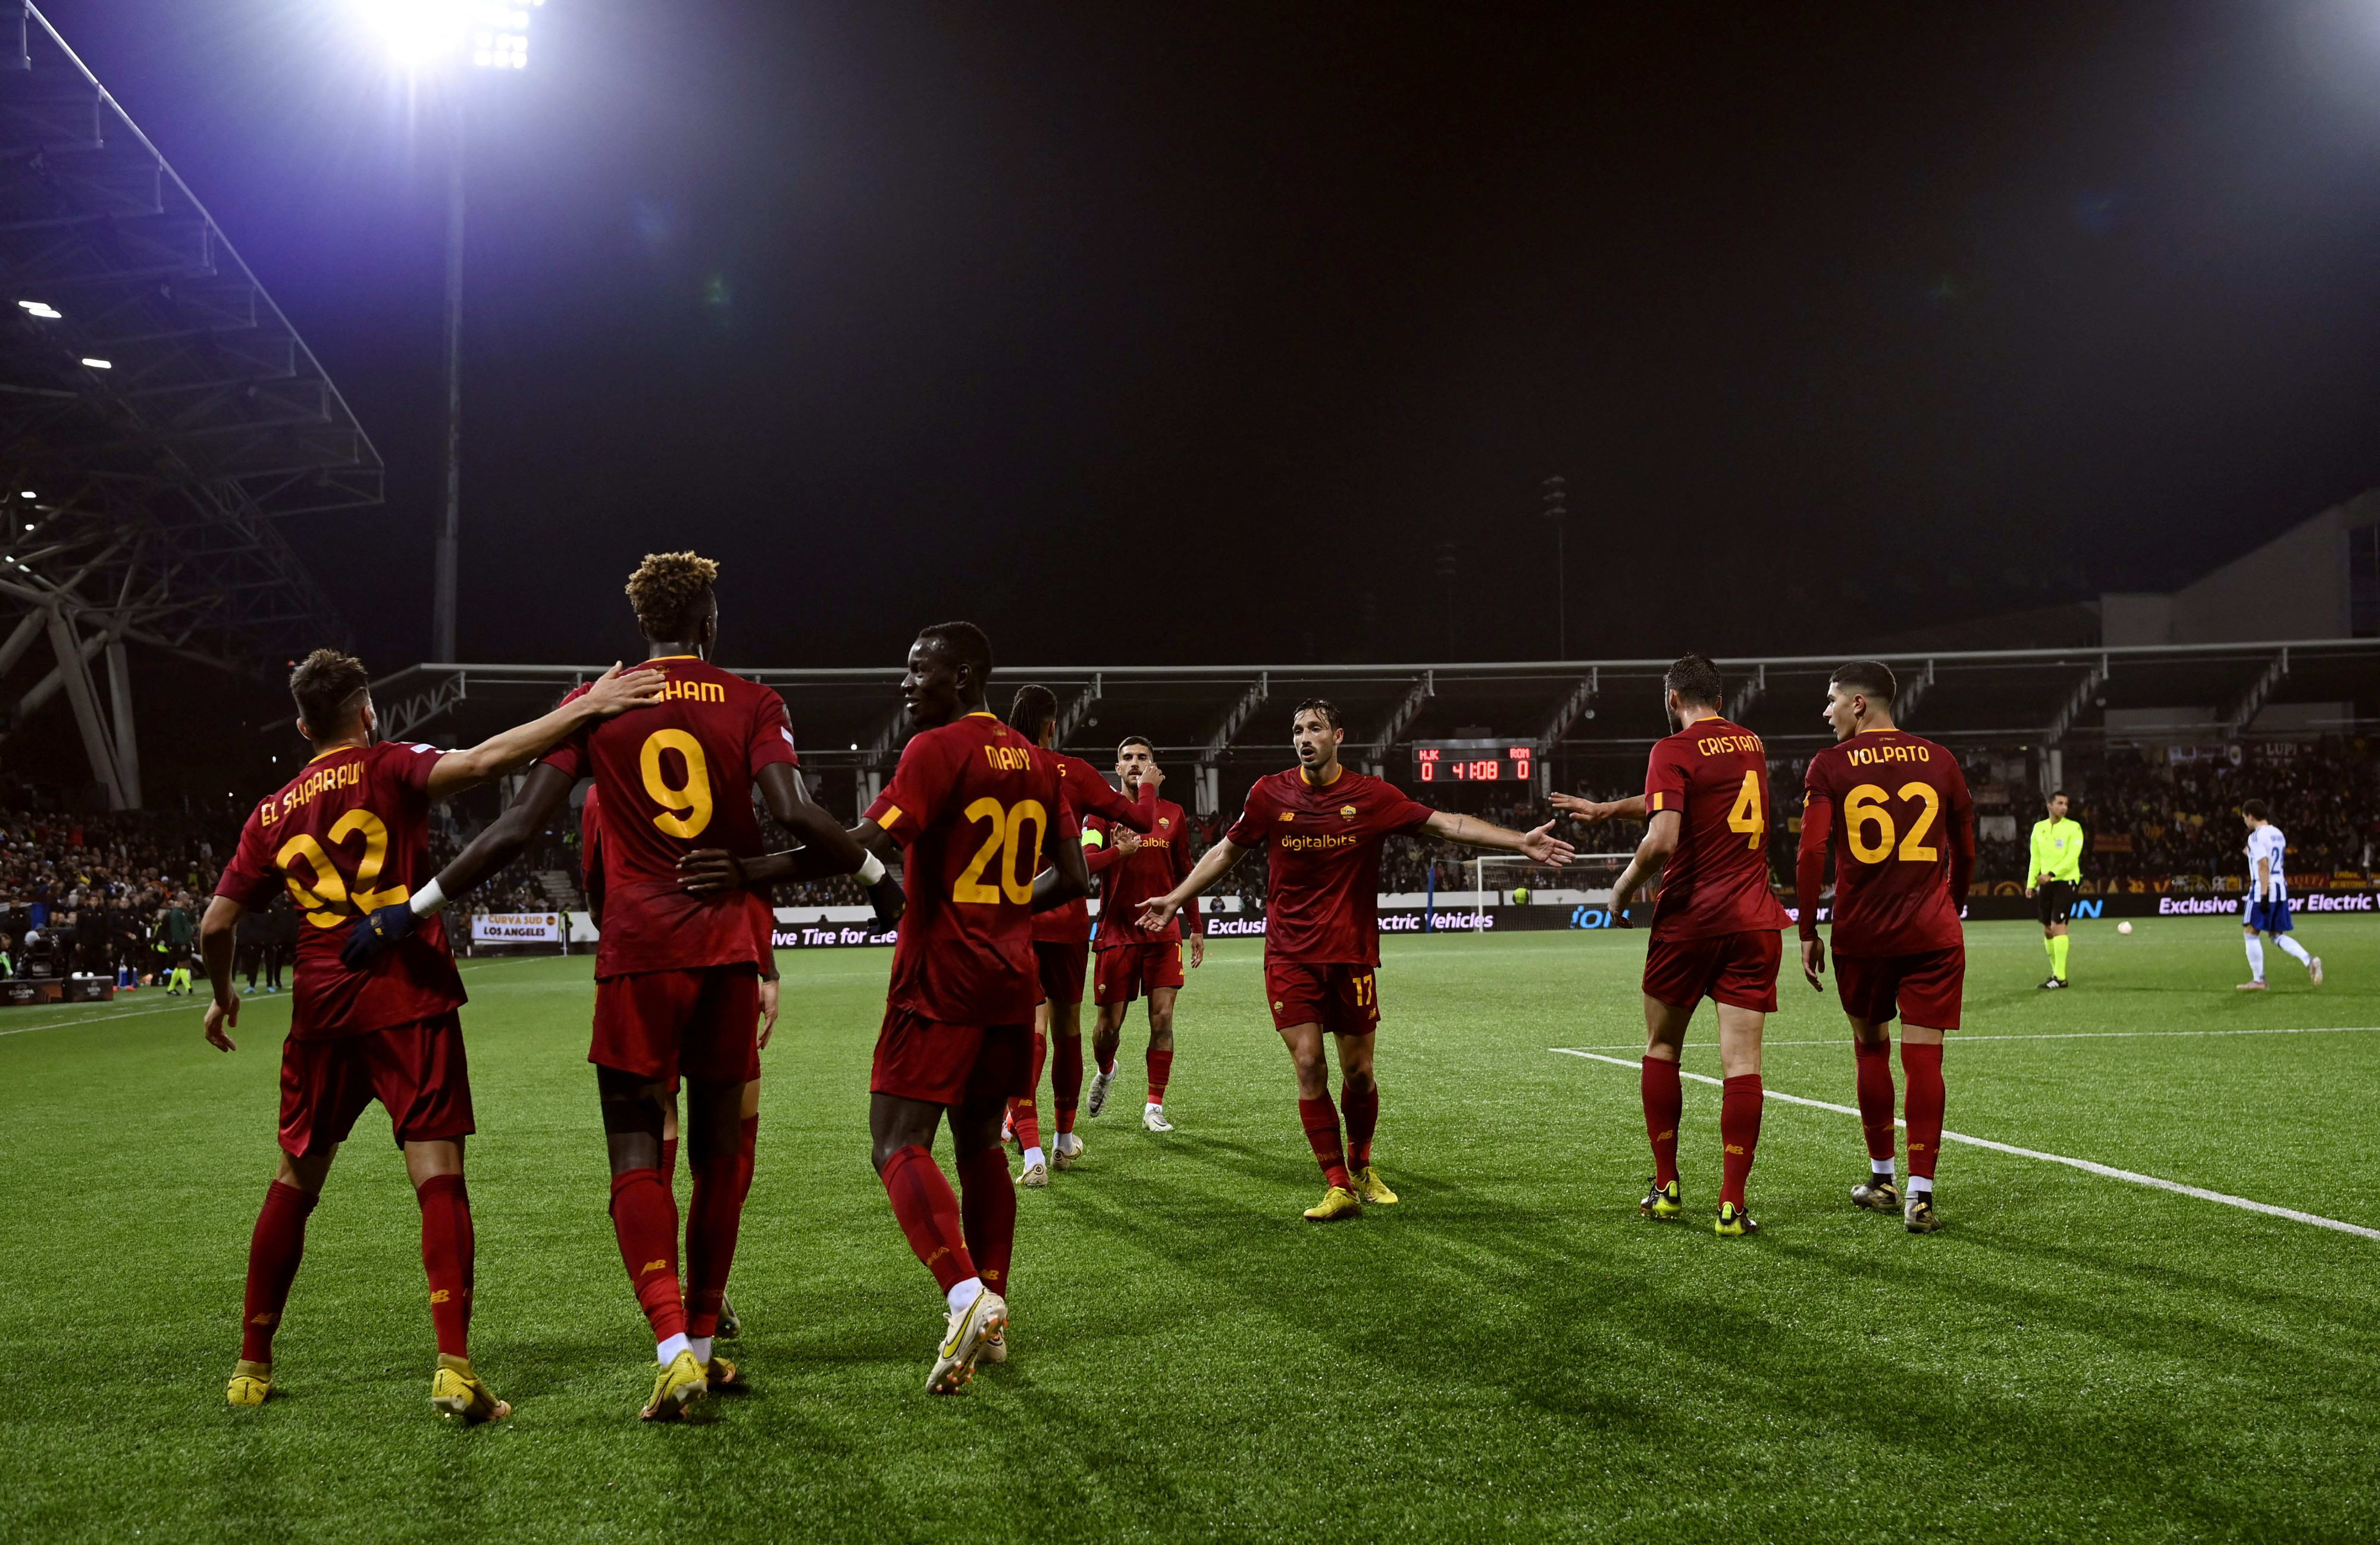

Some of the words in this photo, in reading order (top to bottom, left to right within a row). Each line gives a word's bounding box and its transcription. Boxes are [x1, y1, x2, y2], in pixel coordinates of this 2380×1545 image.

[985, 745, 1031, 771] MADY
[1419, 749, 1439, 761] HJK
[1510, 748, 1530, 759] ROM
[1847, 746, 1929, 767] VOLPATO
[1421, 762, 1433, 781] 0
[1517, 760, 1529, 780] 0
[640, 728, 713, 839] 9
[261, 801, 278, 827] EL
[1727, 770, 1765, 850] 4
[1844, 781, 1939, 864] 62
[953, 797, 1047, 905] 20
[1282, 834, 1357, 851] digitalbits
[277, 809, 409, 928] 92
[2159, 896, 2238, 915] Exclusive
[2307, 893, 2372, 911] Electric
[488, 914, 522, 924] CURVA
[524, 915, 543, 925] SUD
[484, 927, 502, 936] LOS
[504, 927, 546, 936] ANGELES
[801, 928, 836, 945] Tire
[840, 927, 868, 944] for
[1352, 974, 1373, 1006] 17
